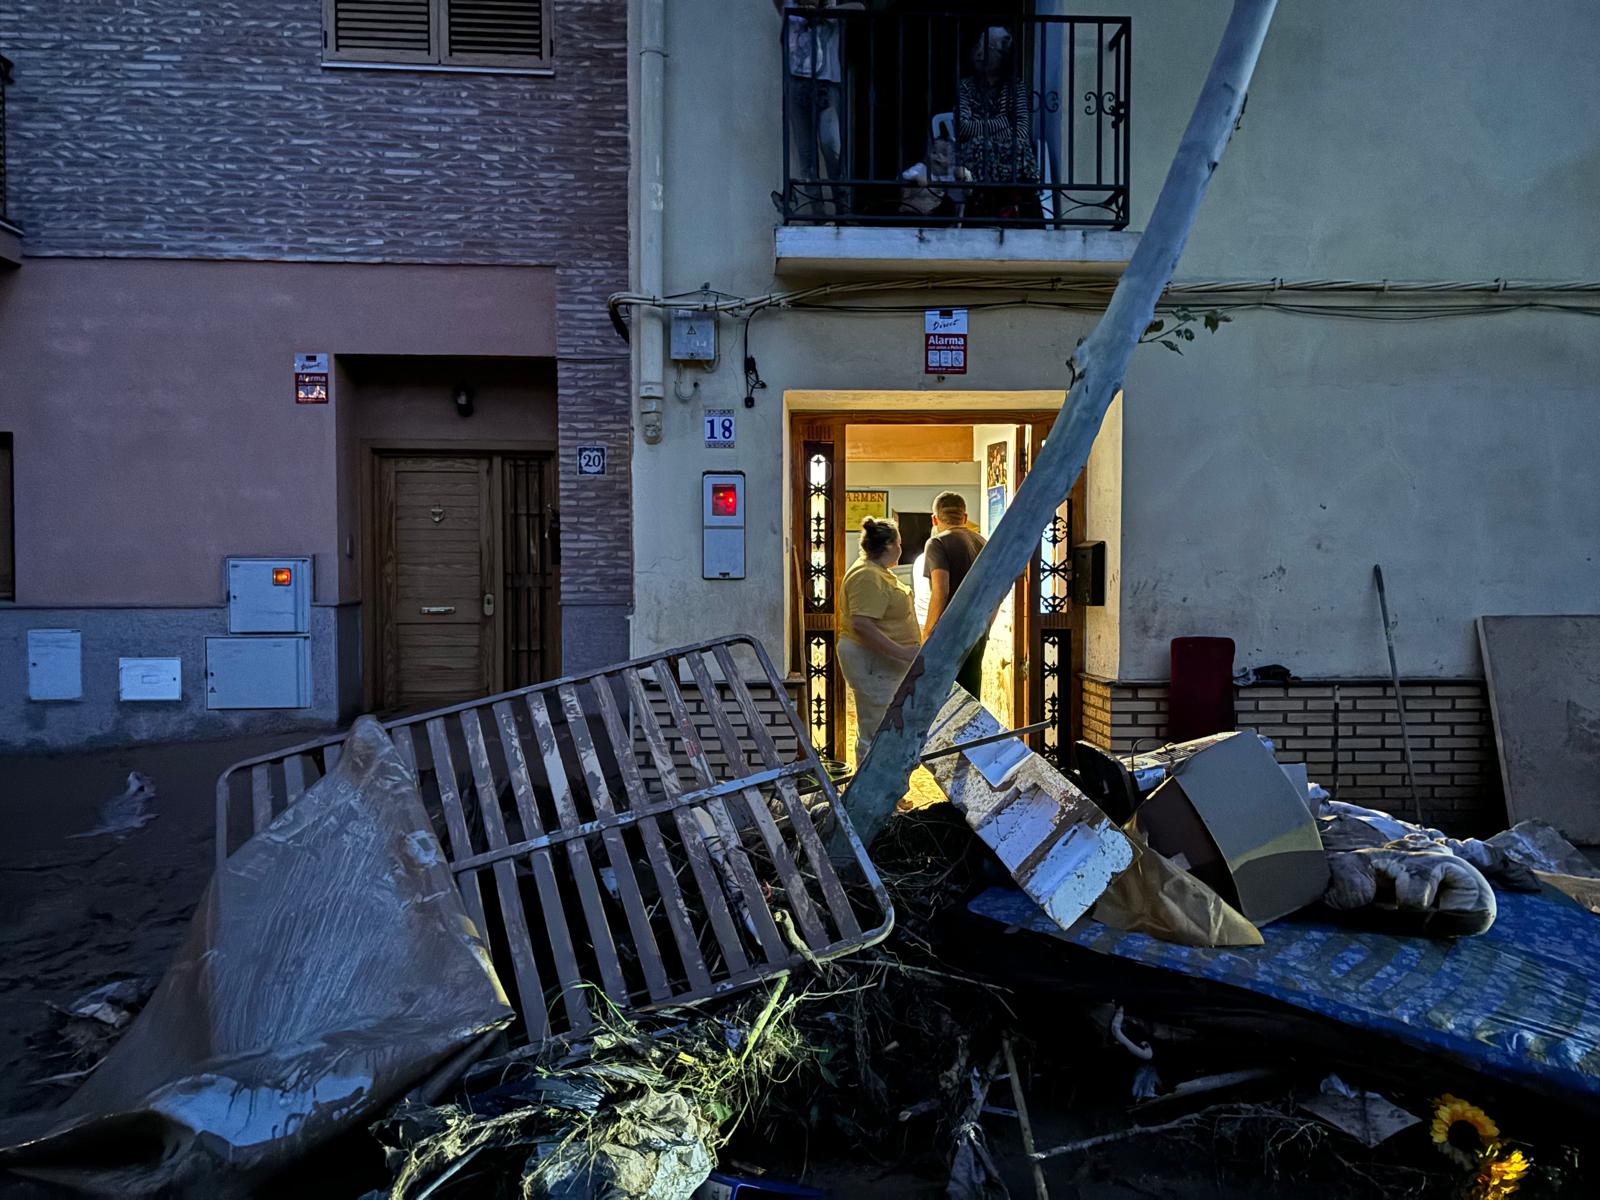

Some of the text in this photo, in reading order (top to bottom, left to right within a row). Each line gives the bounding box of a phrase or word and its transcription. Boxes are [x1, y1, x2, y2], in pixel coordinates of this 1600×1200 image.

[928, 335, 964, 345] Alarma
[707, 418, 733, 439] 18
[583, 455, 601, 467] 20
